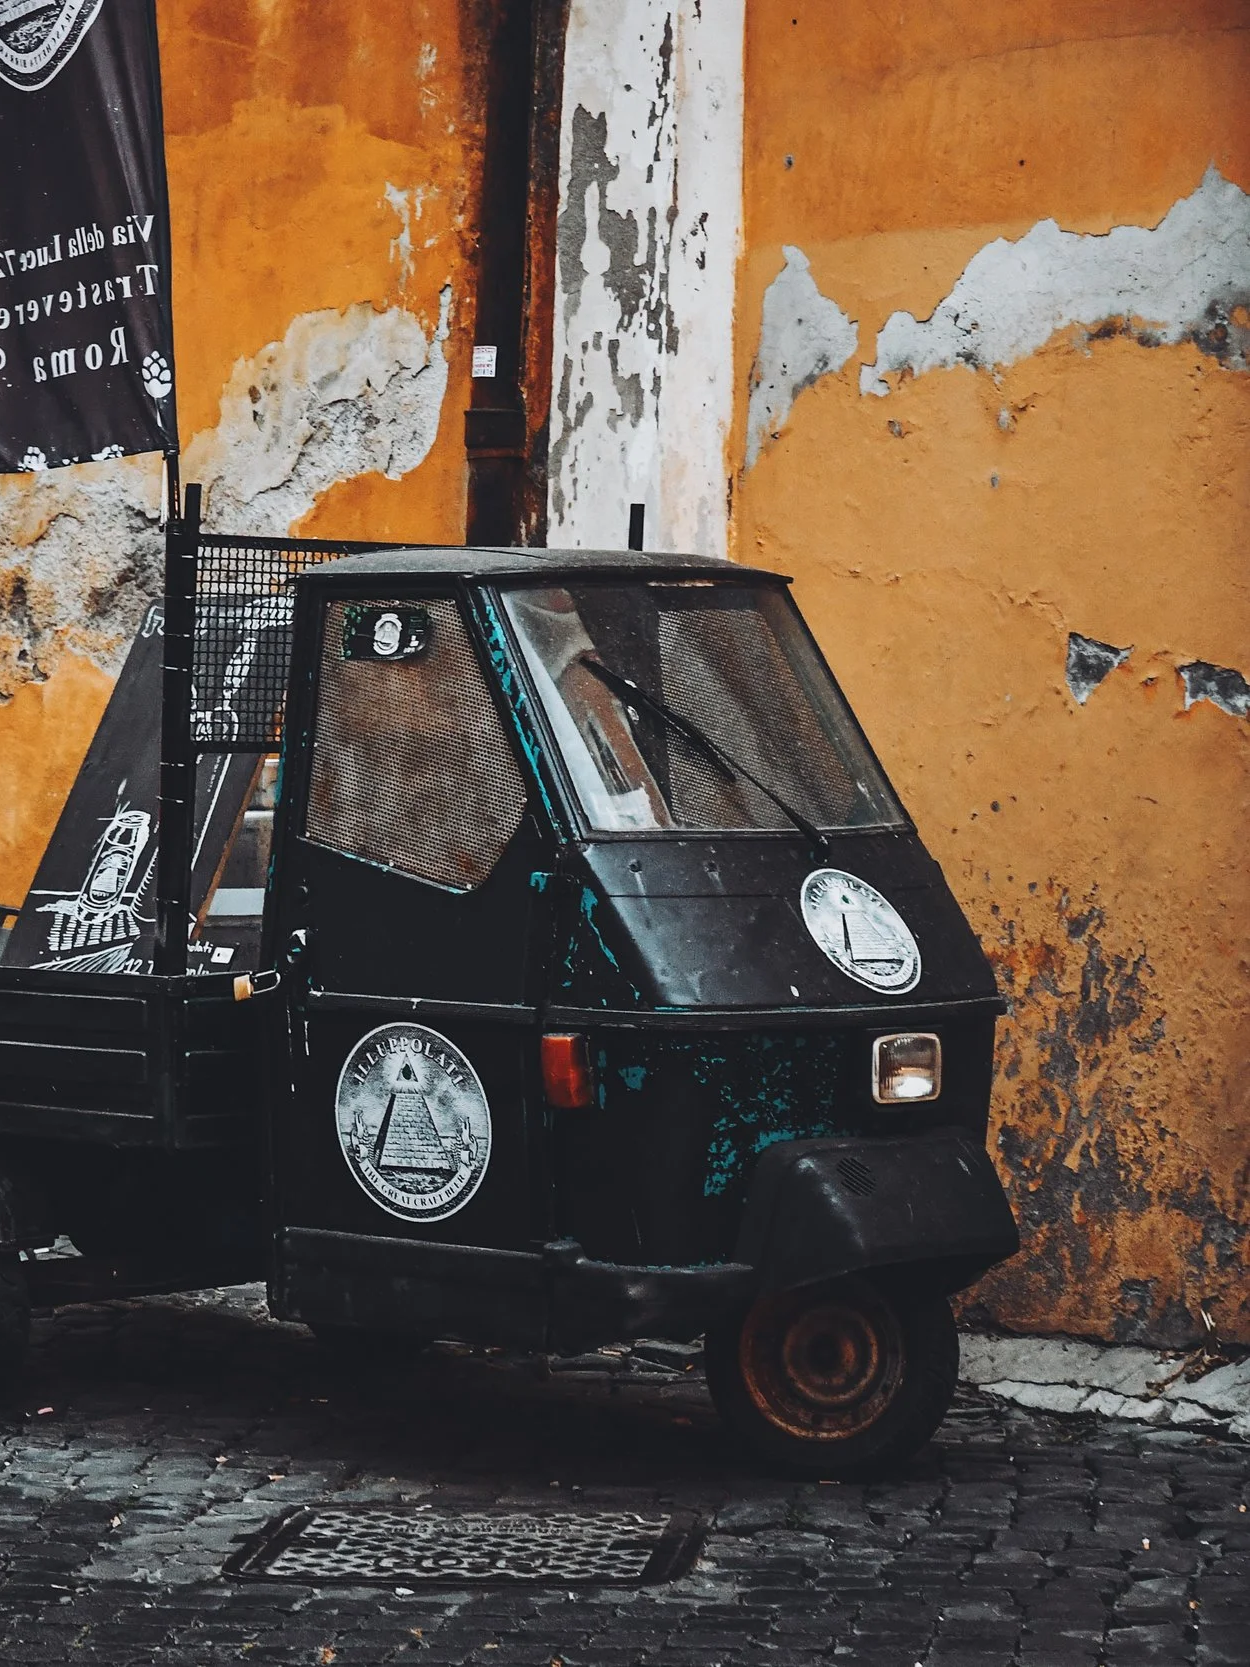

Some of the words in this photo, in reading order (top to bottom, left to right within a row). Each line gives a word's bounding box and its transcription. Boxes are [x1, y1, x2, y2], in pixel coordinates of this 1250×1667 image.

[354, 1037, 465, 1088] ILLUPPOLATI
[364, 1166, 379, 1185] THE
[381, 1184, 411, 1206] GREAT
[413, 1193, 444, 1206] CRAFT
[444, 1174, 466, 1199] BEER
